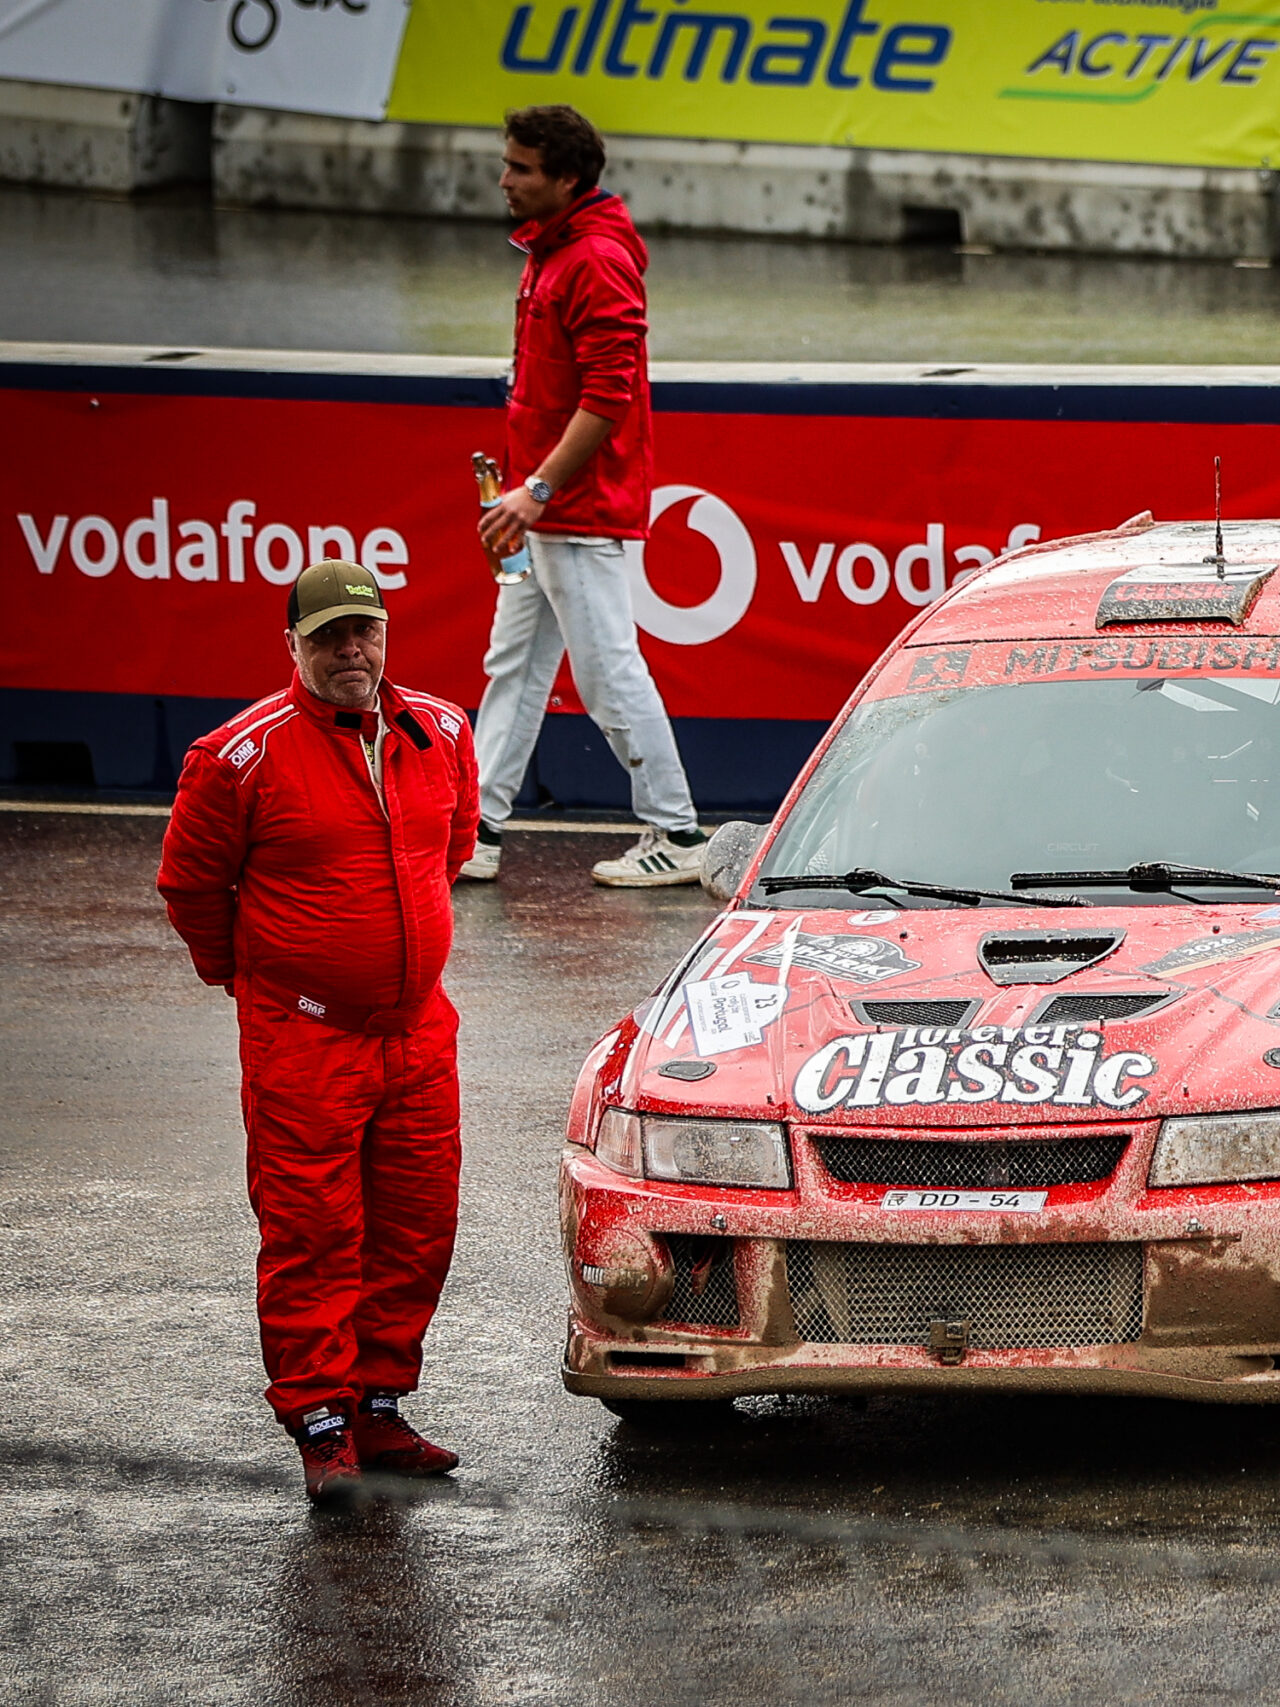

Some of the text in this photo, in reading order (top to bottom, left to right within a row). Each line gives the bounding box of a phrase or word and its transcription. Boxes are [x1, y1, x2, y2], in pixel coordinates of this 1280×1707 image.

[501, 0, 953, 94] ultimate
[1026, 29, 1280, 86] ACTIVE
[17, 497, 409, 591] vodafone
[231, 741, 256, 766] OMP
[298, 998, 326, 1017] OMP
[754, 993, 778, 1009] 23
[794, 1031, 1153, 1113] Classic
[919, 1193, 961, 1207] DD
[989, 1194, 1021, 1207] 54
[308, 1415, 344, 1435] sparco
